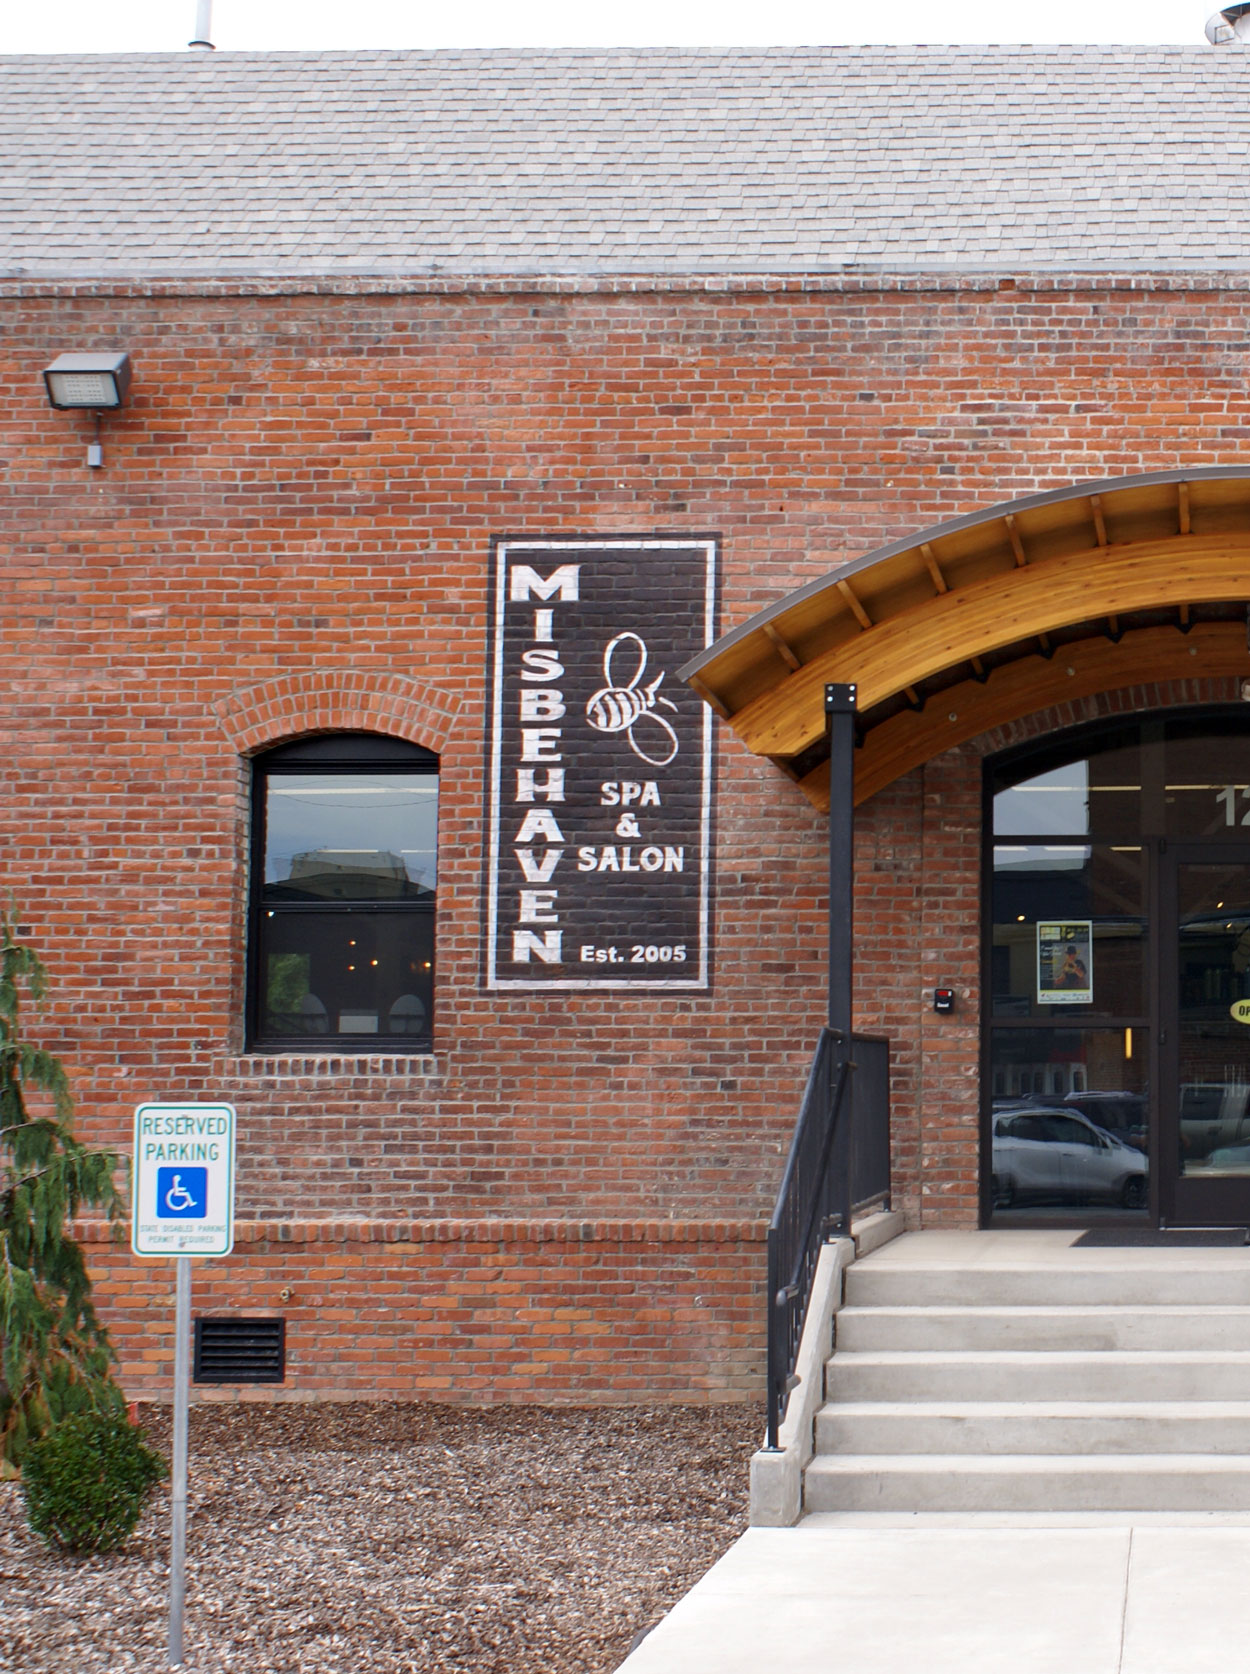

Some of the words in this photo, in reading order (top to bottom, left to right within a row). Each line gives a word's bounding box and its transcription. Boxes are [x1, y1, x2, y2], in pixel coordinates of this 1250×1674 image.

[510, 563, 581, 964] MISBEHAVEN
[600, 781, 661, 807] SPA
[615, 812, 642, 838] &
[577, 846, 684, 872] SALON
[579, 944, 625, 963] Est.
[630, 944, 687, 963] 2005
[142, 1116, 228, 1136] RESERVED
[145, 1142, 219, 1161] PARKING
[140, 1224, 159, 1233] STATE
[163, 1224, 193, 1233] DISABLED
[198, 1224, 227, 1233] PARKING
[148, 1235, 174, 1244] PERMIT
[179, 1235, 215, 1244] REQUIRED
